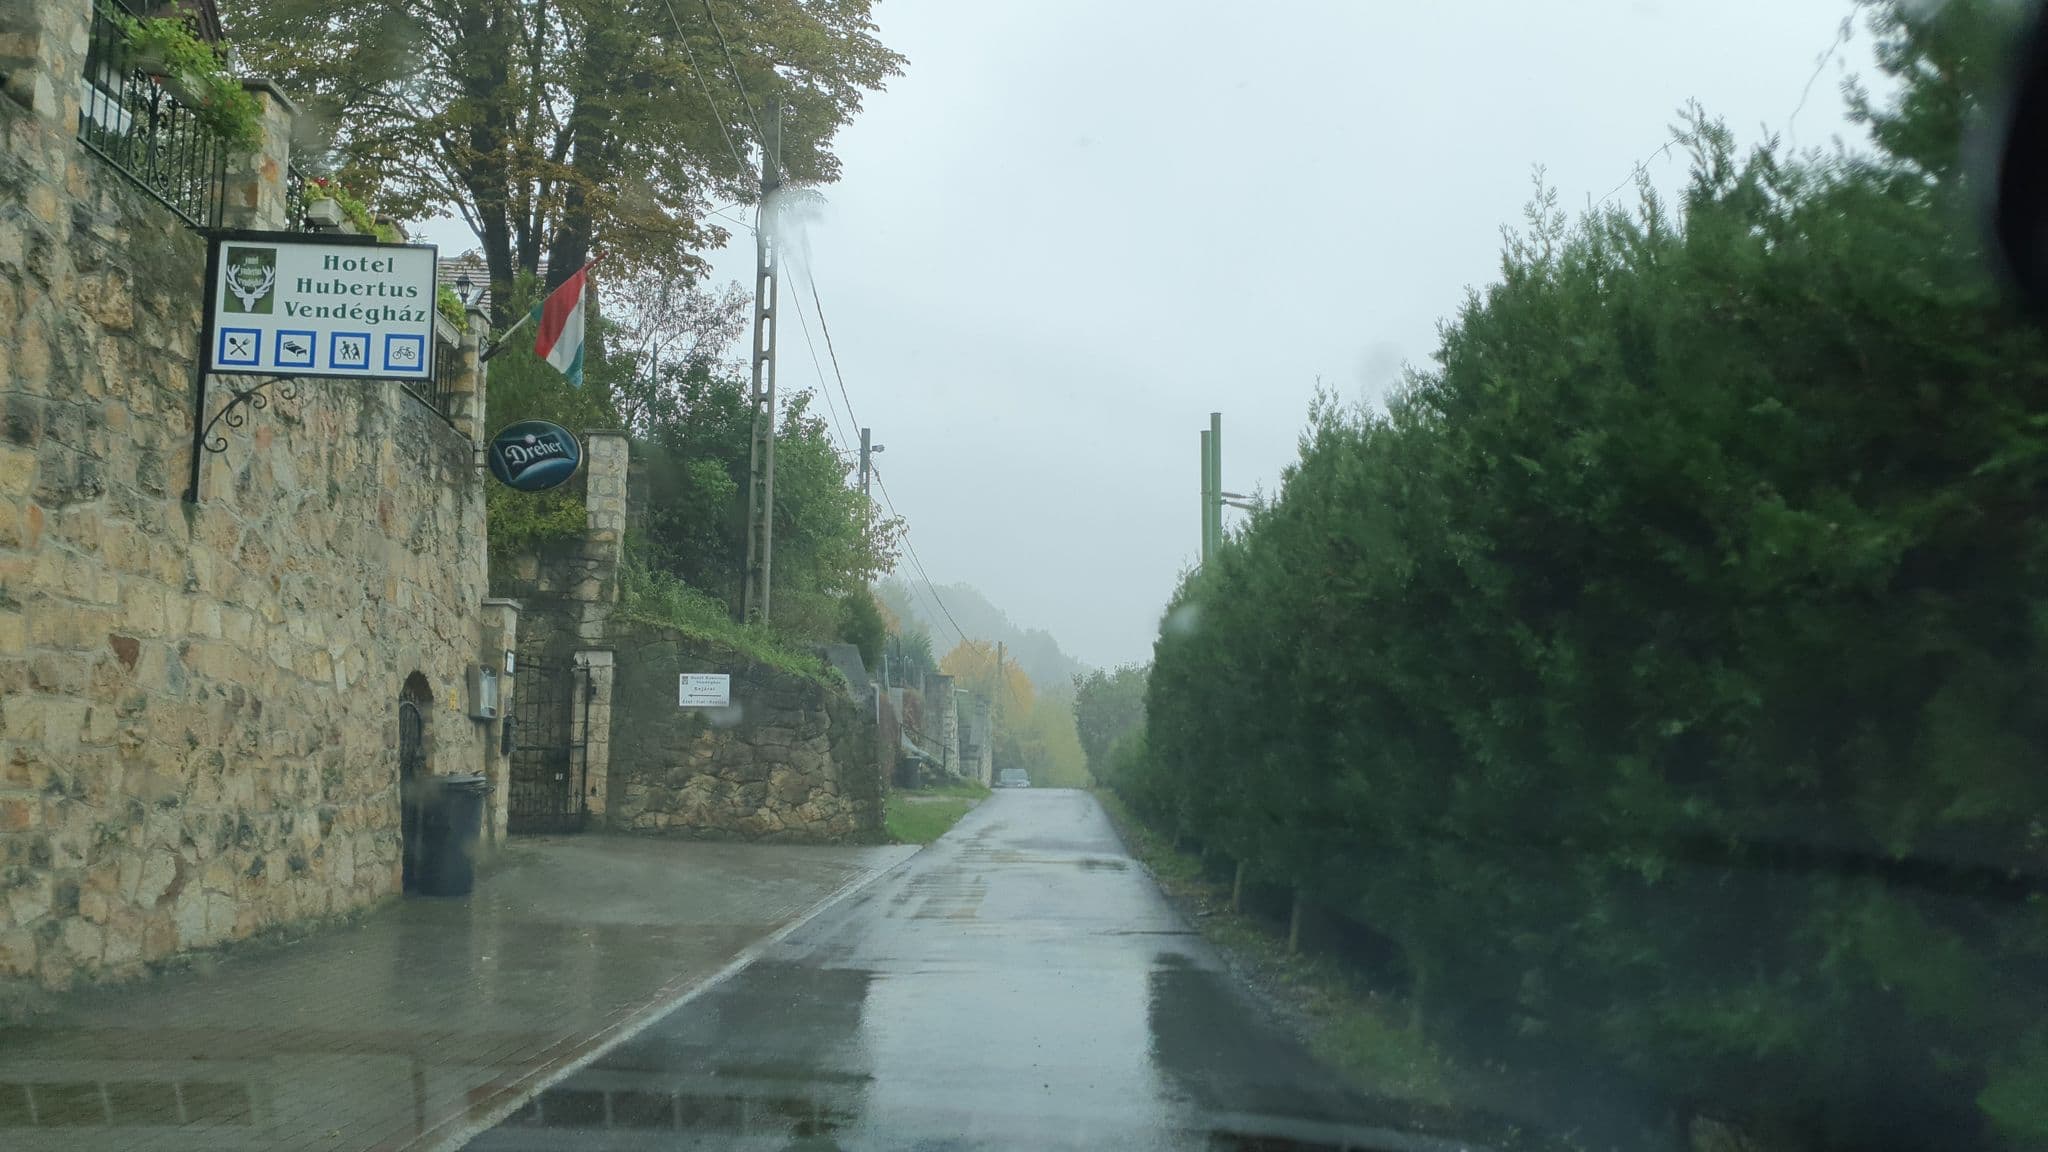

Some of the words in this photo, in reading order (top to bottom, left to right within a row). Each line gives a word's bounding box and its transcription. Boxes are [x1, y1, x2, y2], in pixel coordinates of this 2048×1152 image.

[323, 255, 394, 273] Hotel
[296, 278, 418, 298] Hubertus
[284, 301, 426, 325] Vendégház
[505, 439, 563, 465] Dreher
